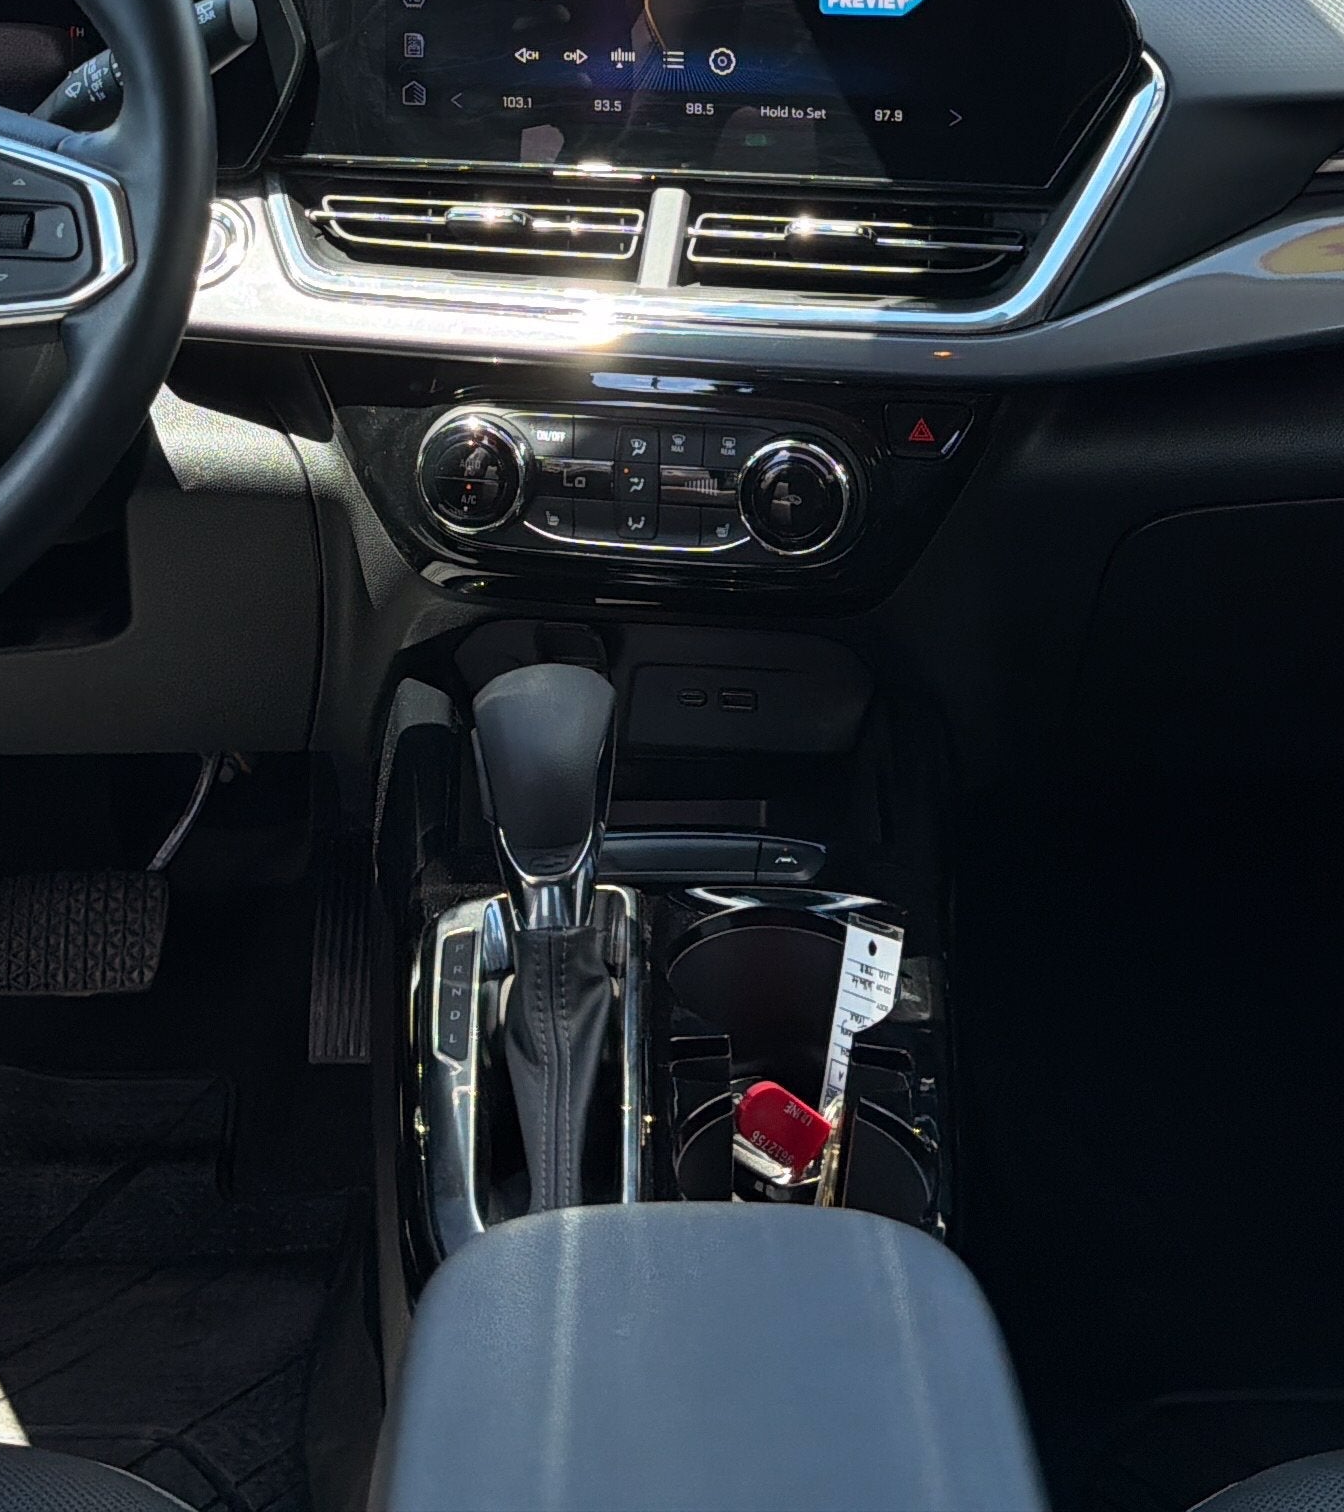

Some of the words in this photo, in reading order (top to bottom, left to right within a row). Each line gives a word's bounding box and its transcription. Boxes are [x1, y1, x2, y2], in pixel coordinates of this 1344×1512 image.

[75, 27, 85, 38] H
[526, 50, 539, 60] CH
[563, 51, 578, 61] CH
[502, 96, 533, 110] 103.1
[593, 99, 623, 113] 93.5
[685, 101, 715, 116] 98.5
[760, 105, 788, 118] Hold
[791, 106, 804, 119] to
[806, 106, 827, 120] Set
[874, 109, 903, 123] 97.9
[536, 430, 567, 442] ON/OFF
[670, 444, 685, 454] MAX
[720, 447, 736, 456] REAR
[459, 493, 477, 505] A/C
[455, 943, 464, 953] P
[453, 965, 463, 975] R
[451, 986, 462, 997] N
[449, 1009, 461, 1021] D
[448, 1033, 458, 1044] L
